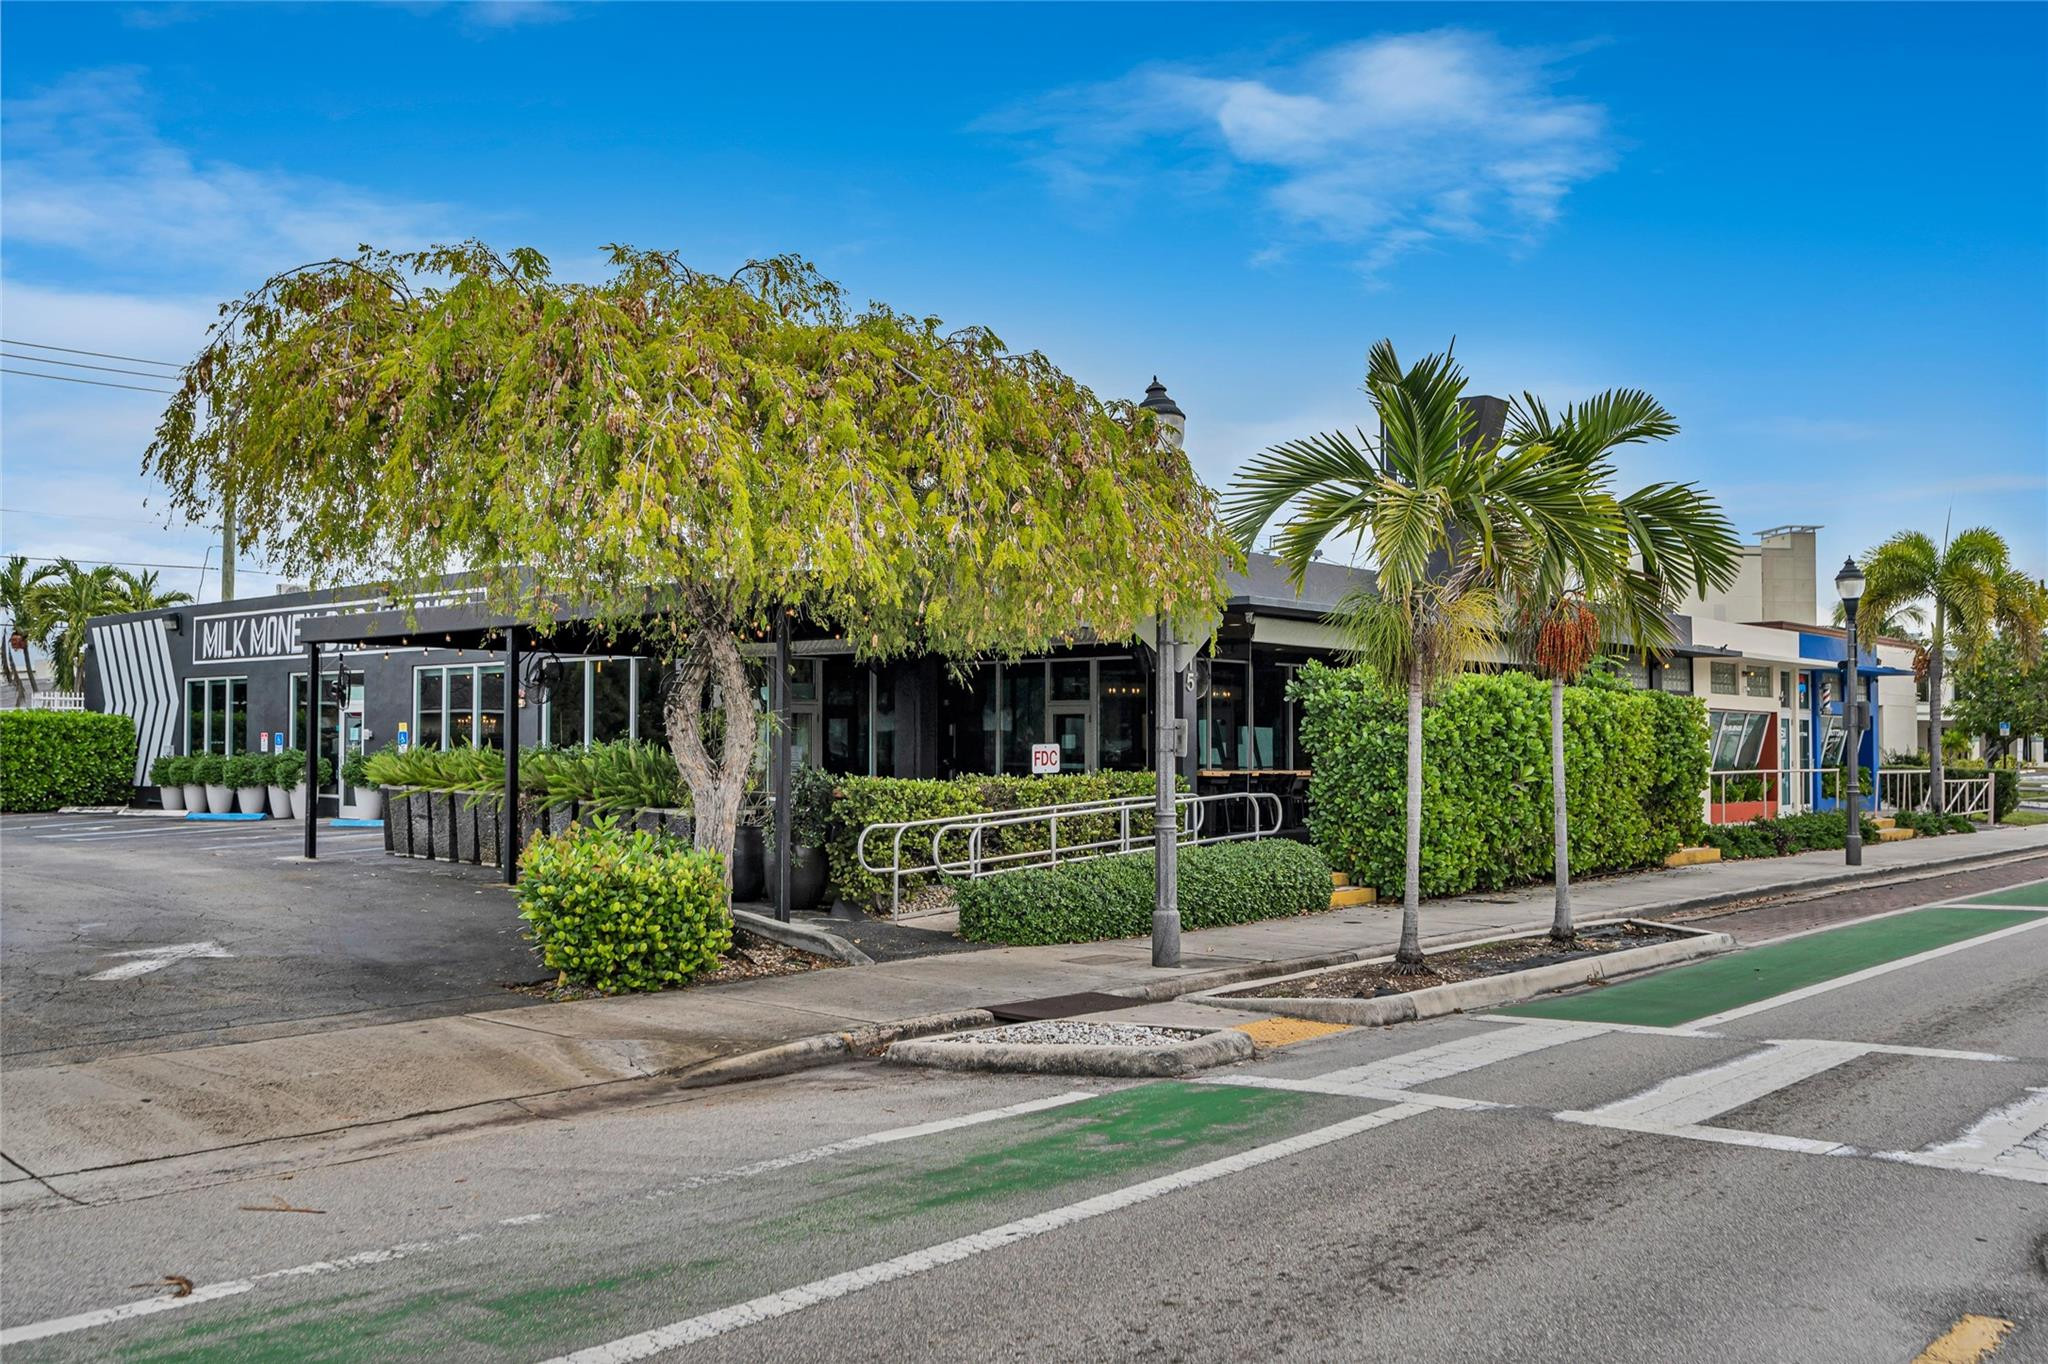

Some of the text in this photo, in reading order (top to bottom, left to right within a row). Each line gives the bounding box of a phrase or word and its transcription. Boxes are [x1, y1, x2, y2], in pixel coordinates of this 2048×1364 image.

[202, 619, 246, 659] MILK
[249, 612, 318, 656] MONE
[1034, 750, 1058, 766] FDC
